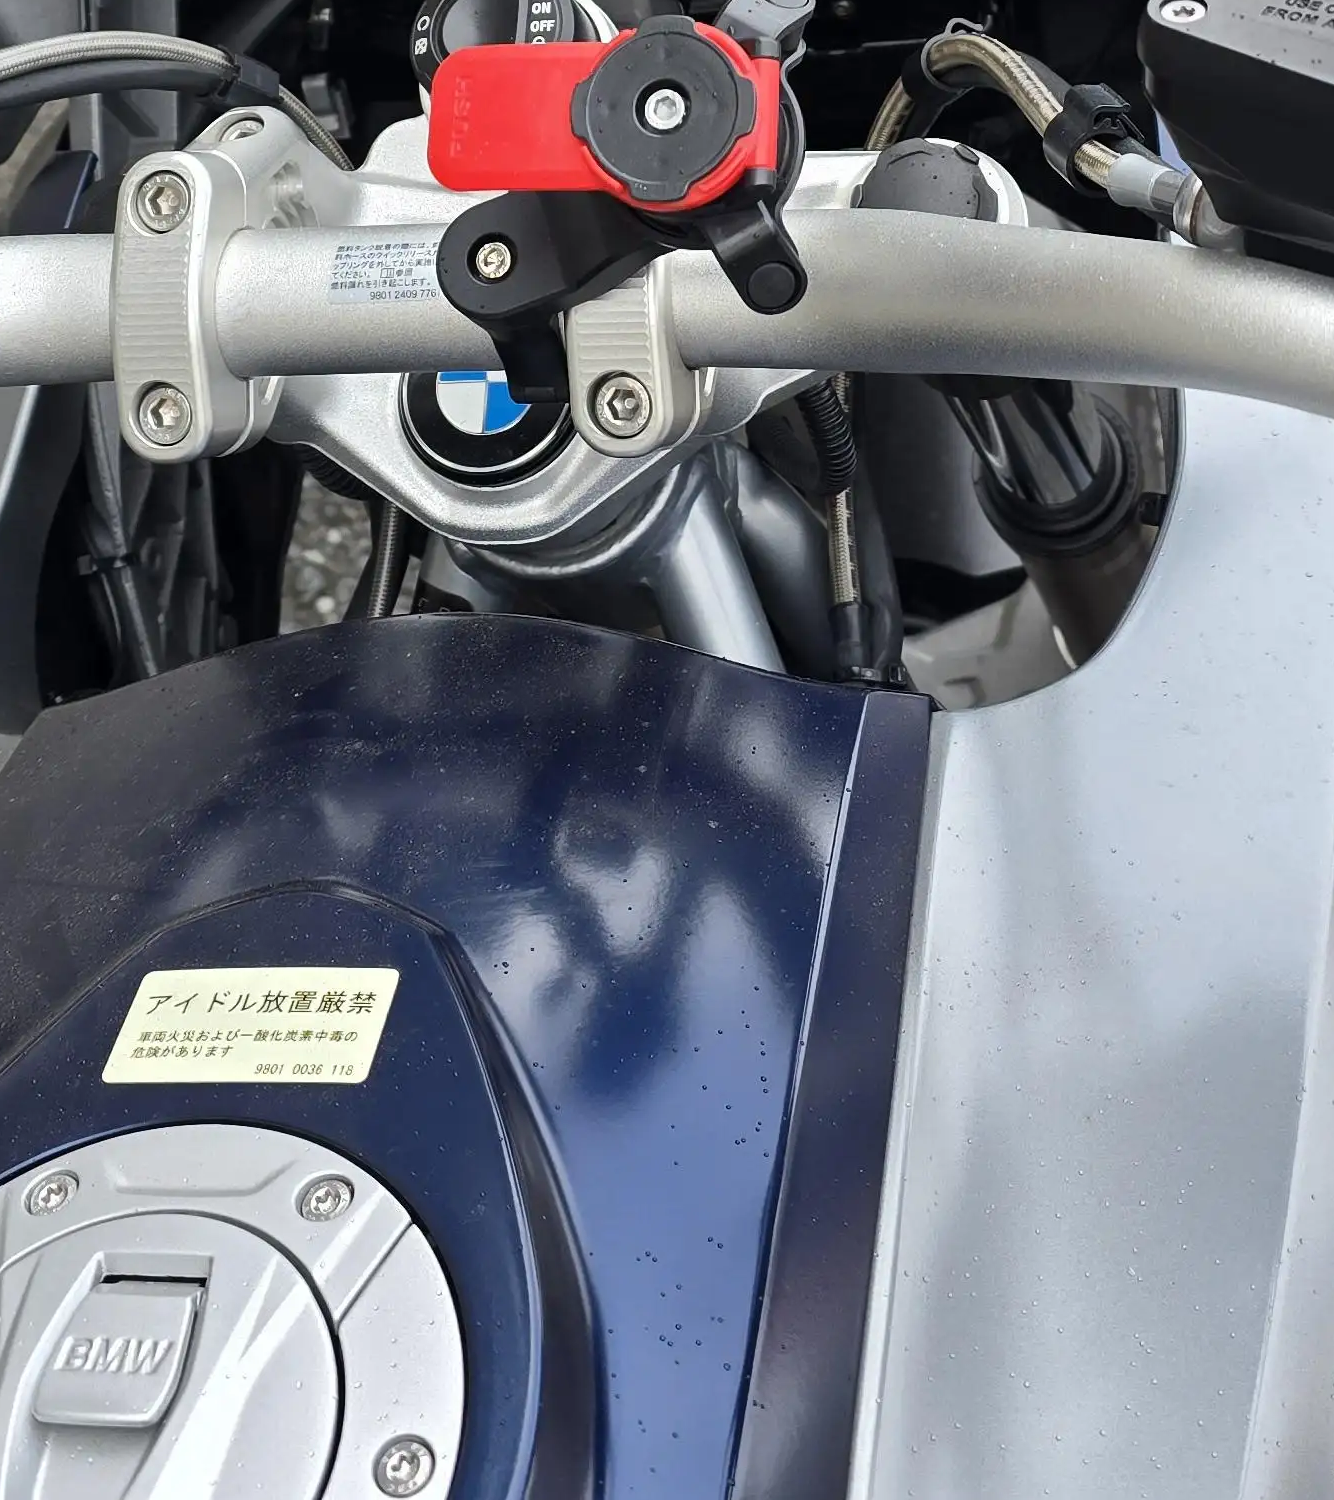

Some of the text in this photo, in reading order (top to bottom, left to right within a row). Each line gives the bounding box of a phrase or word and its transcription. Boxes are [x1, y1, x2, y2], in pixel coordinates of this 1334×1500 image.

[531, 1, 552, 14] ON
[1260, 5, 1320, 24] FROM
[530, 19, 556, 33] OFF
[370, 288, 437, 300] 9801 2409 776
[146, 990, 378, 1015] アイドル放置厳禁
[130, 1046, 234, 1059] 危険があります
[254, 1063, 355, 1076] 9801 0036 118
[53, 1336, 174, 1375] BMW
